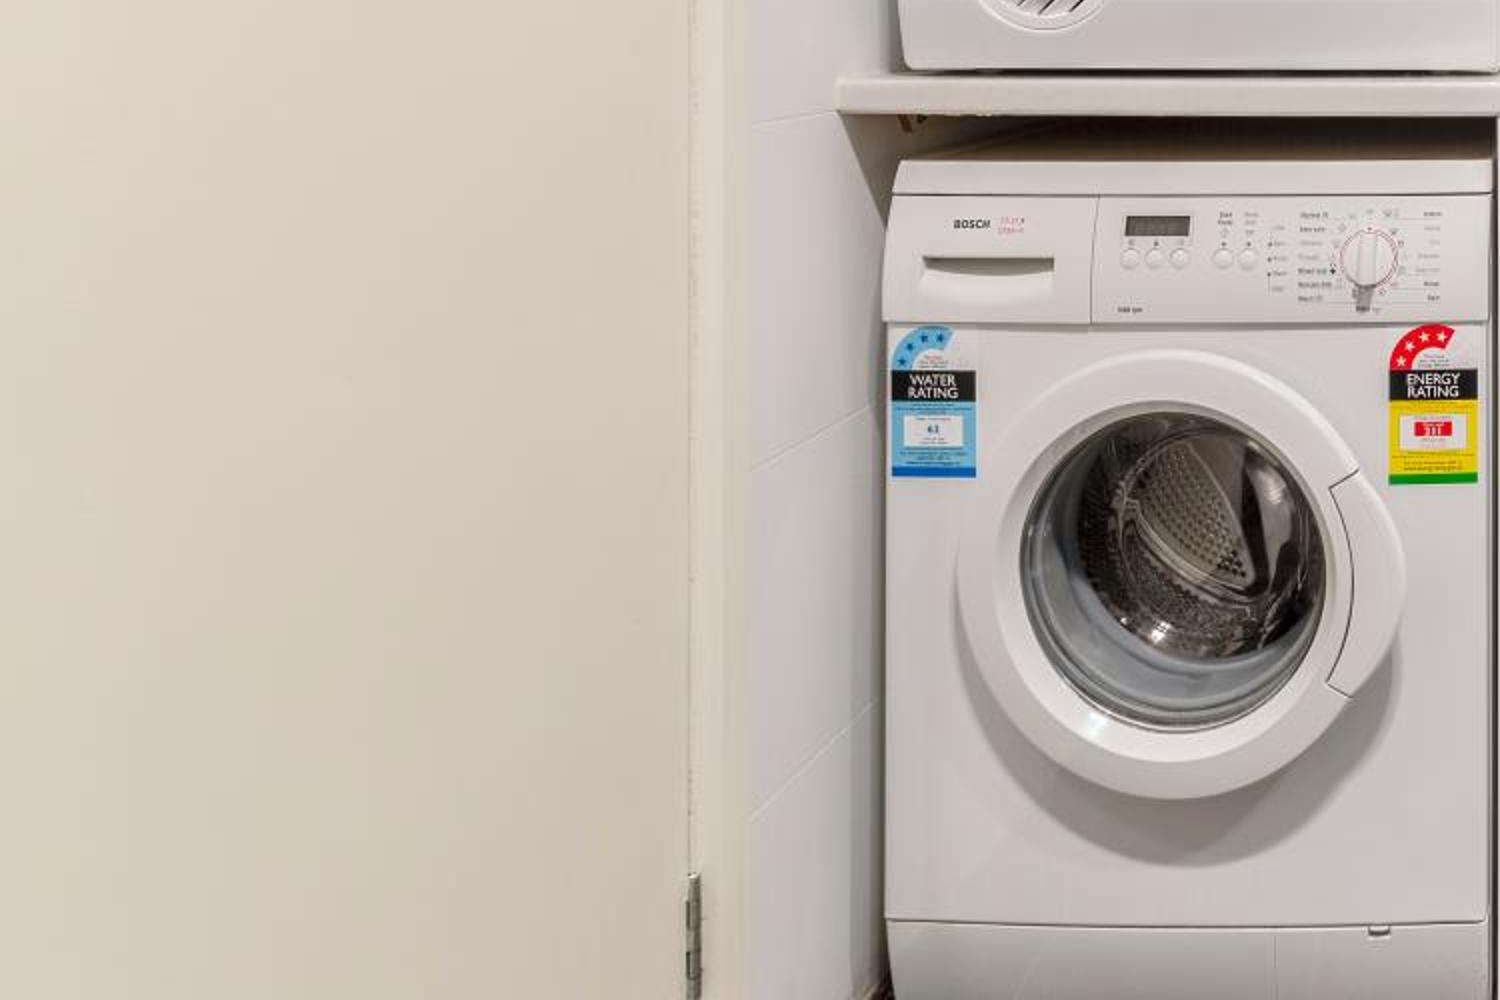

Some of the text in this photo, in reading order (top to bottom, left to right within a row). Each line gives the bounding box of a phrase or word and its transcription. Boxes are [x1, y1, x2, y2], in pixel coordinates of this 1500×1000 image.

[953, 219, 991, 229] BOSCH
[909, 373, 957, 387] WATER
[1406, 373, 1461, 386] ENERGY
[907, 387, 959, 399] RATING
[1407, 386, 1460, 399] RATING
